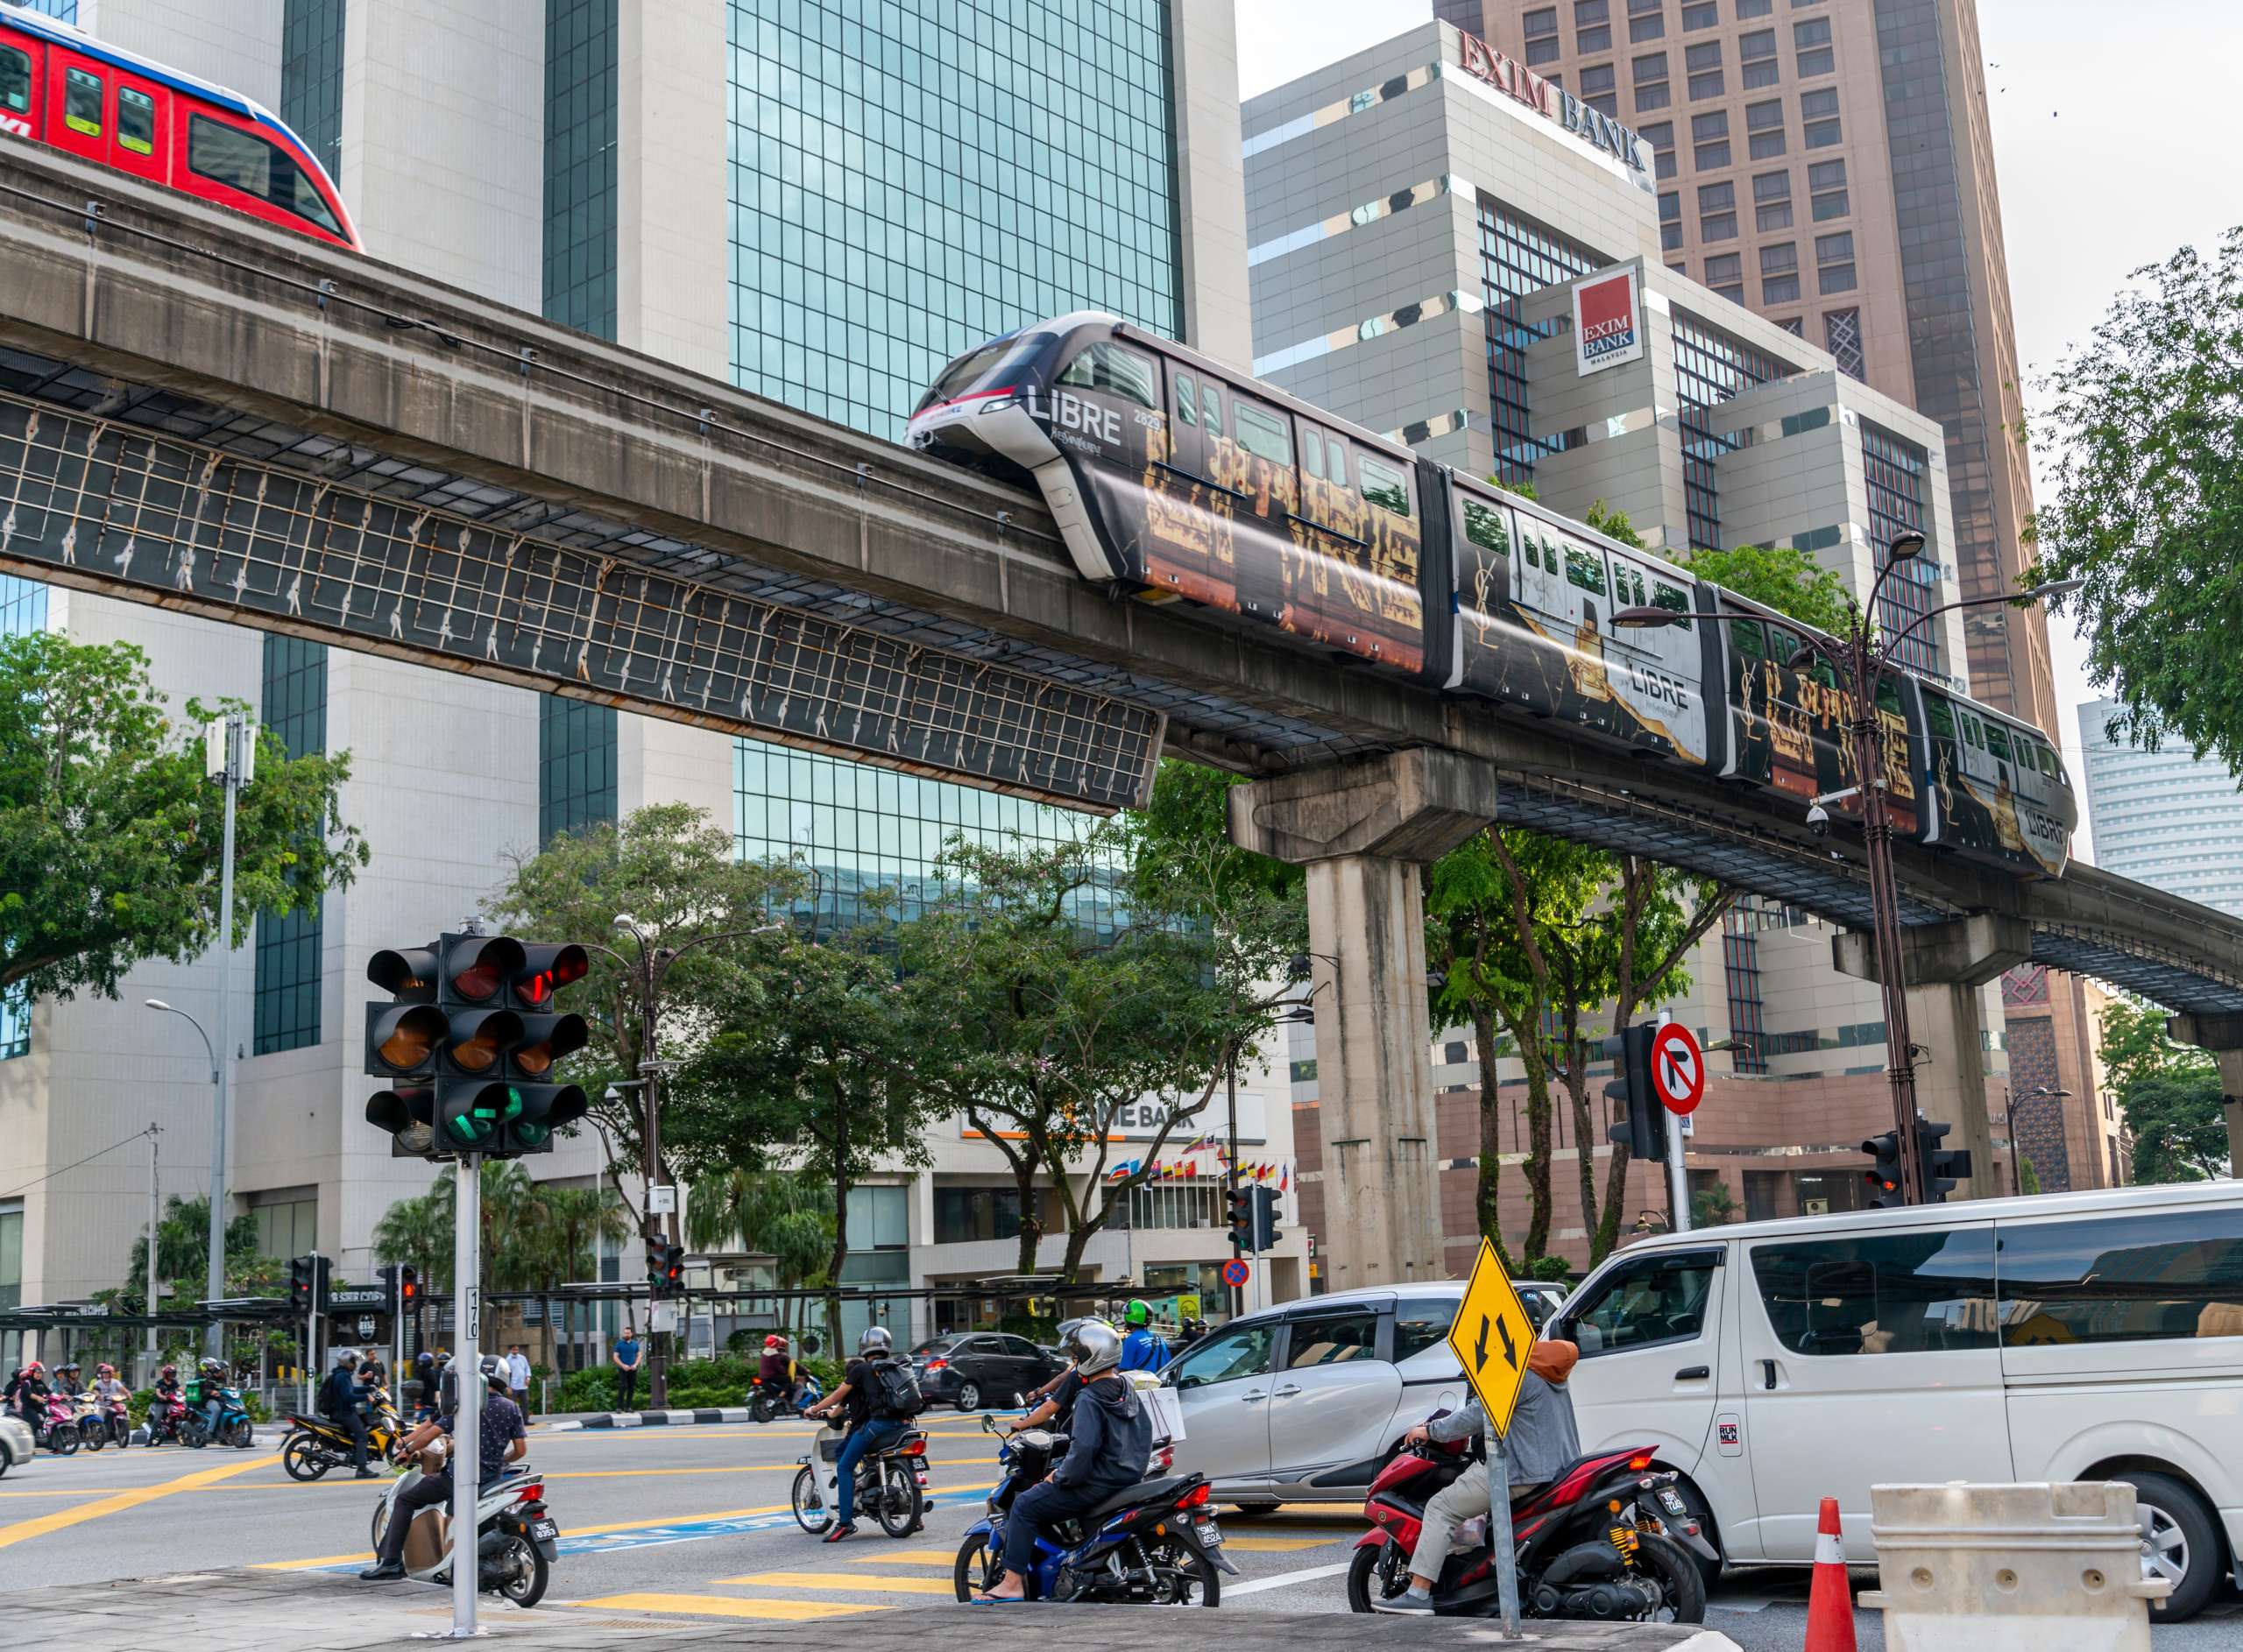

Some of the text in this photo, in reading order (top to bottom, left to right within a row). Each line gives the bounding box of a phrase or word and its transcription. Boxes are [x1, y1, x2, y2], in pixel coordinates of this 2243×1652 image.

[1458, 29, 1646, 172] EXIM BANK
[1583, 315, 1629, 341] EXIM
[1584, 332, 1631, 357] BANK
[1590, 349, 1627, 364] MALAYSIA
[1027, 385, 1122, 447] LIBRE
[1134, 409, 1161, 430] 2829
[1630, 663, 1688, 710] LIBRE
[1140, 1105, 1195, 1129] BAK
